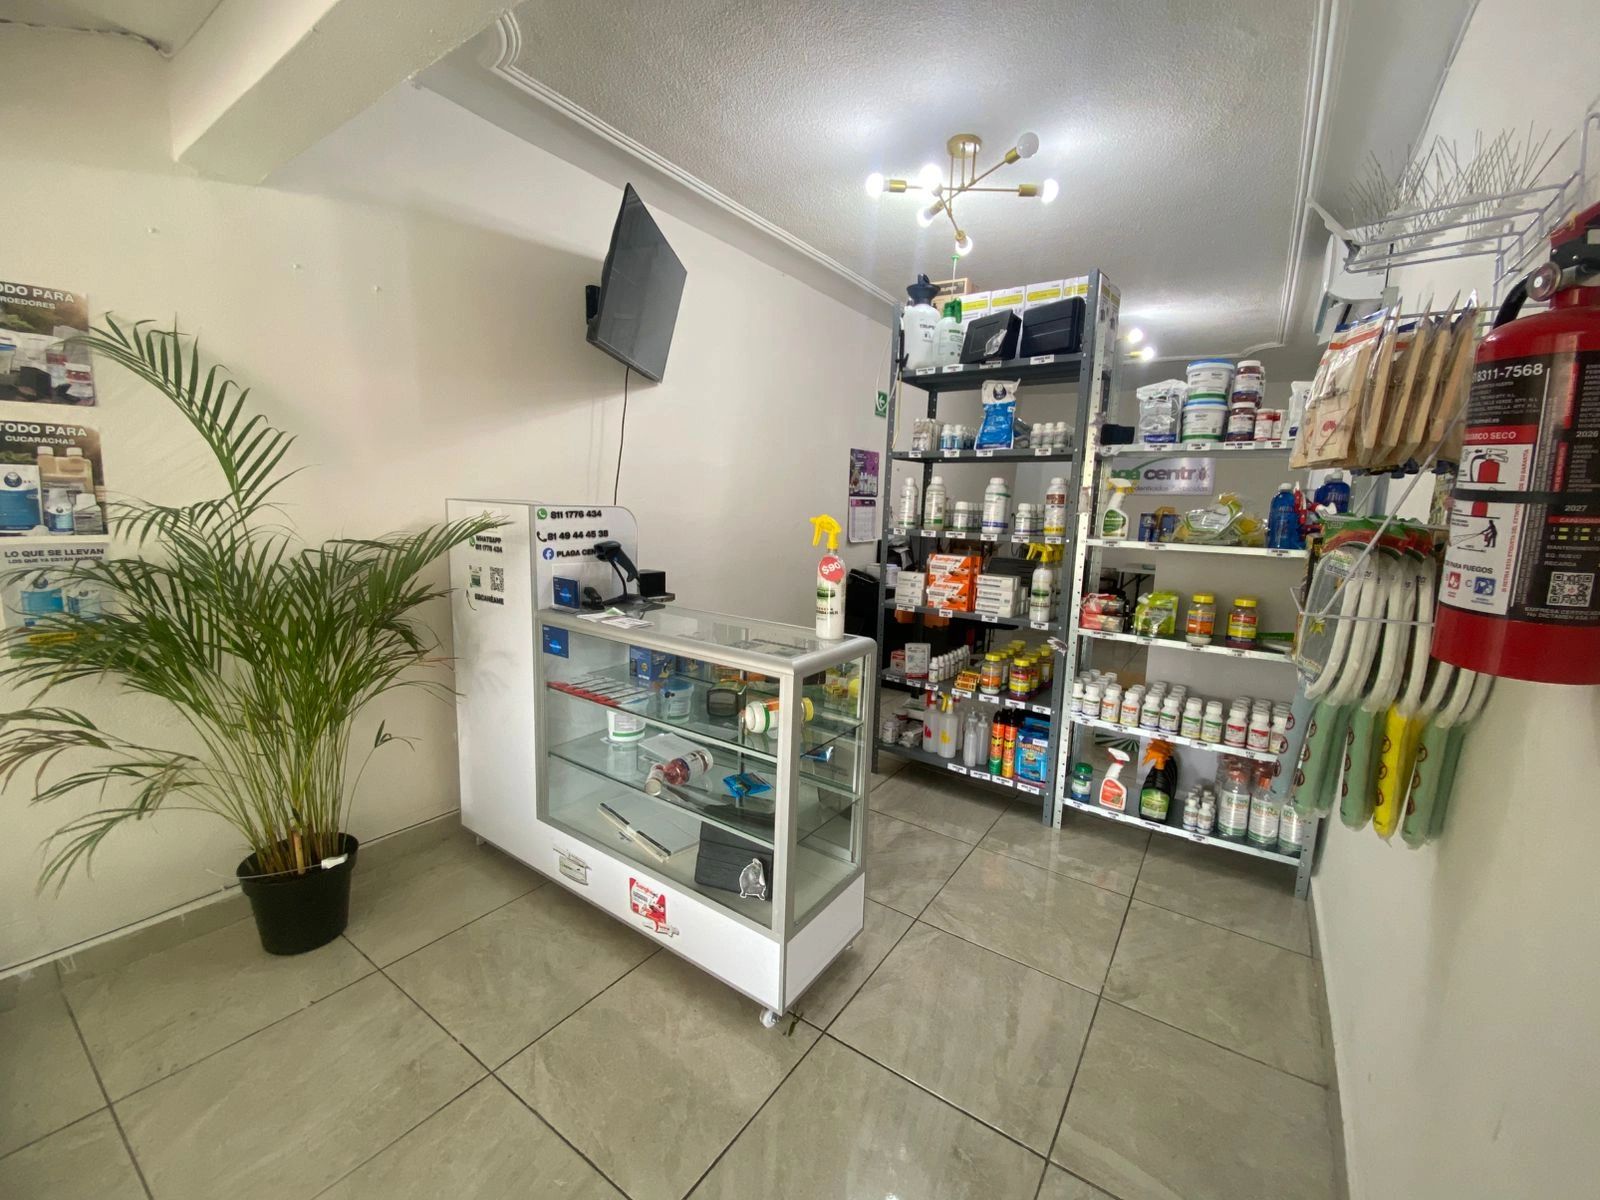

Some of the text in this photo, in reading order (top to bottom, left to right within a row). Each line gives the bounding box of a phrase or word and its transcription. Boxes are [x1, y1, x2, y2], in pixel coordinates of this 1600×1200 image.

[0, 284, 74, 303] ODO PARA
[0, 423, 87, 437] TODO PARA
[5, 435, 75, 445] CUCARACHAS
[1490, 431, 1517, 440] SECO
[550, 510, 563, 519] 811
[586, 509, 602, 518] 434
[475, 535, 502, 544] WHATSAPP
[559, 532, 571, 540] 49
[573, 531, 584, 539] 44
[21, 550, 45, 558] QUE
[822, 561, 841, 574] $90
[1463, 563, 1494, 575] FUEGOS
